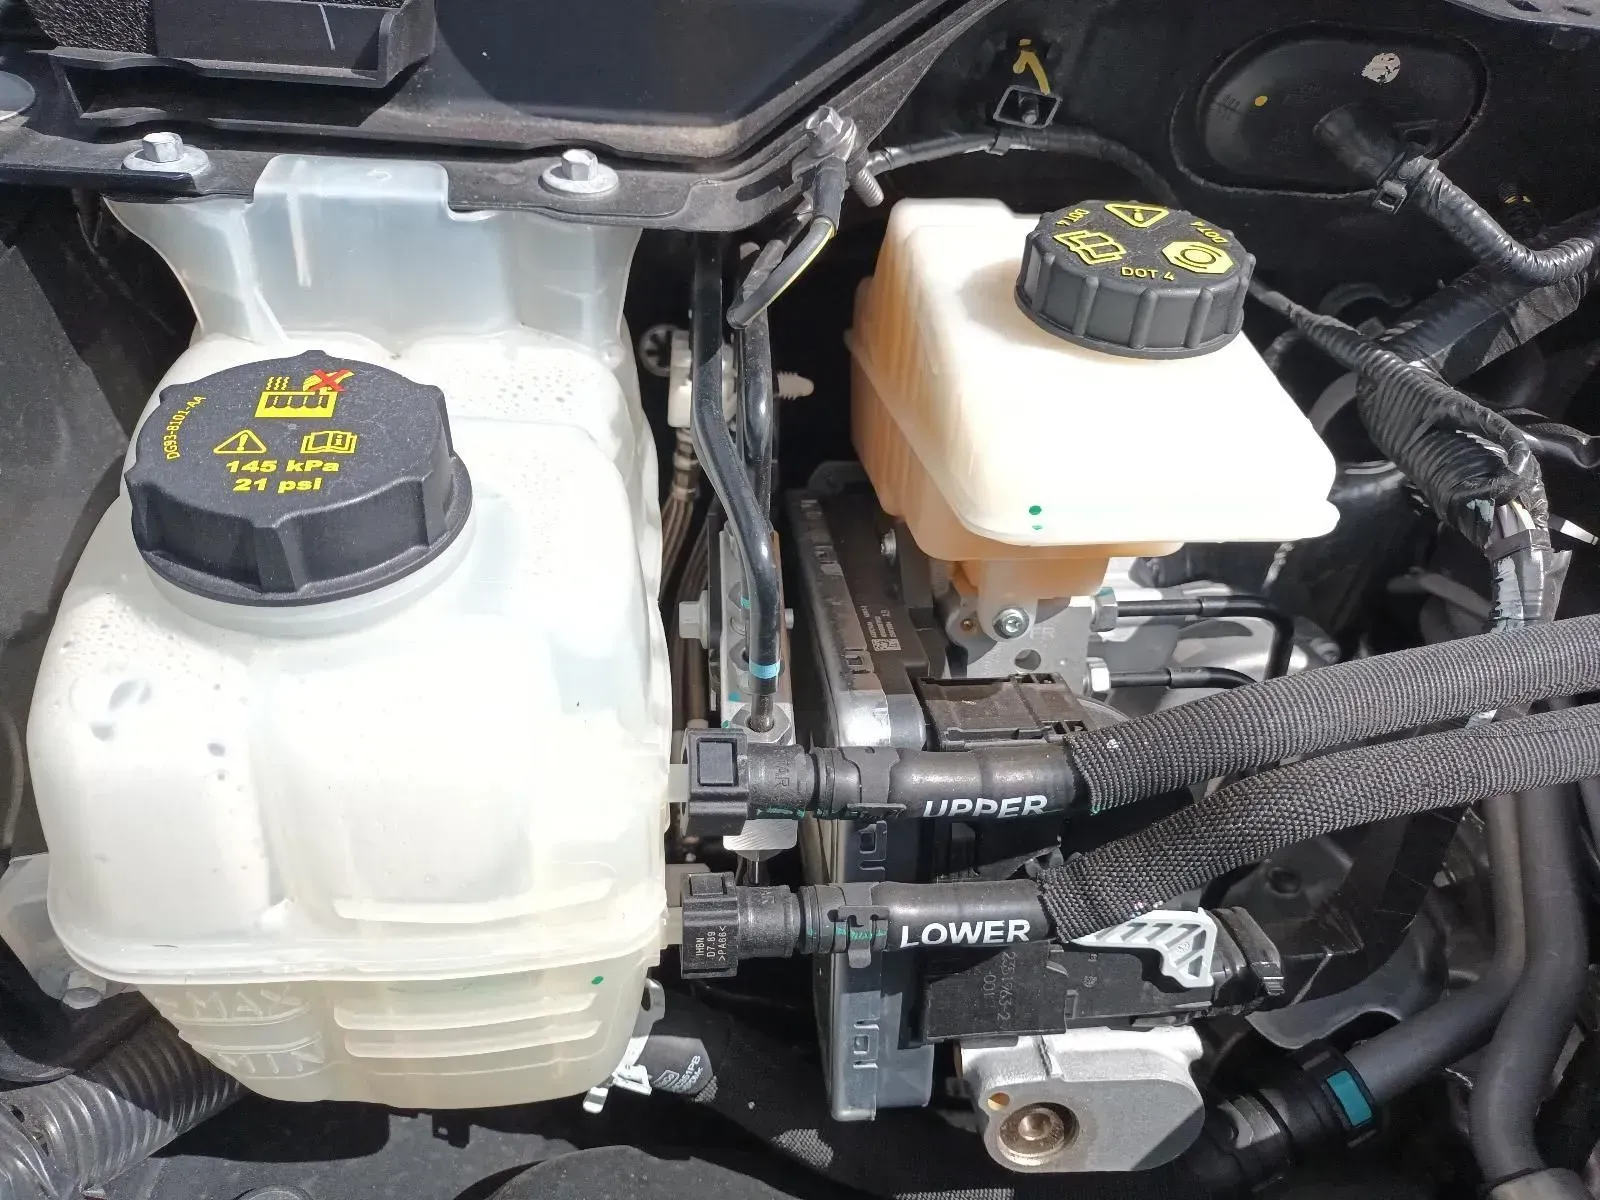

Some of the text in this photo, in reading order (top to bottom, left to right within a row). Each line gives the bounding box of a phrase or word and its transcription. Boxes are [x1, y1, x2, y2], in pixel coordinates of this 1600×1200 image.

[1064, 208, 1091, 223] DOT
[1196, 226, 1230, 244] DOT
[1121, 266, 1175, 281] DOT 4
[163, 395, 207, 461] DG93-8101-AA
[226, 459, 340, 473] 145 kPa
[232, 477, 323, 494] 21 psi
[922, 794, 1048, 819] UPPER
[900, 919, 1031, 948] LOWER
